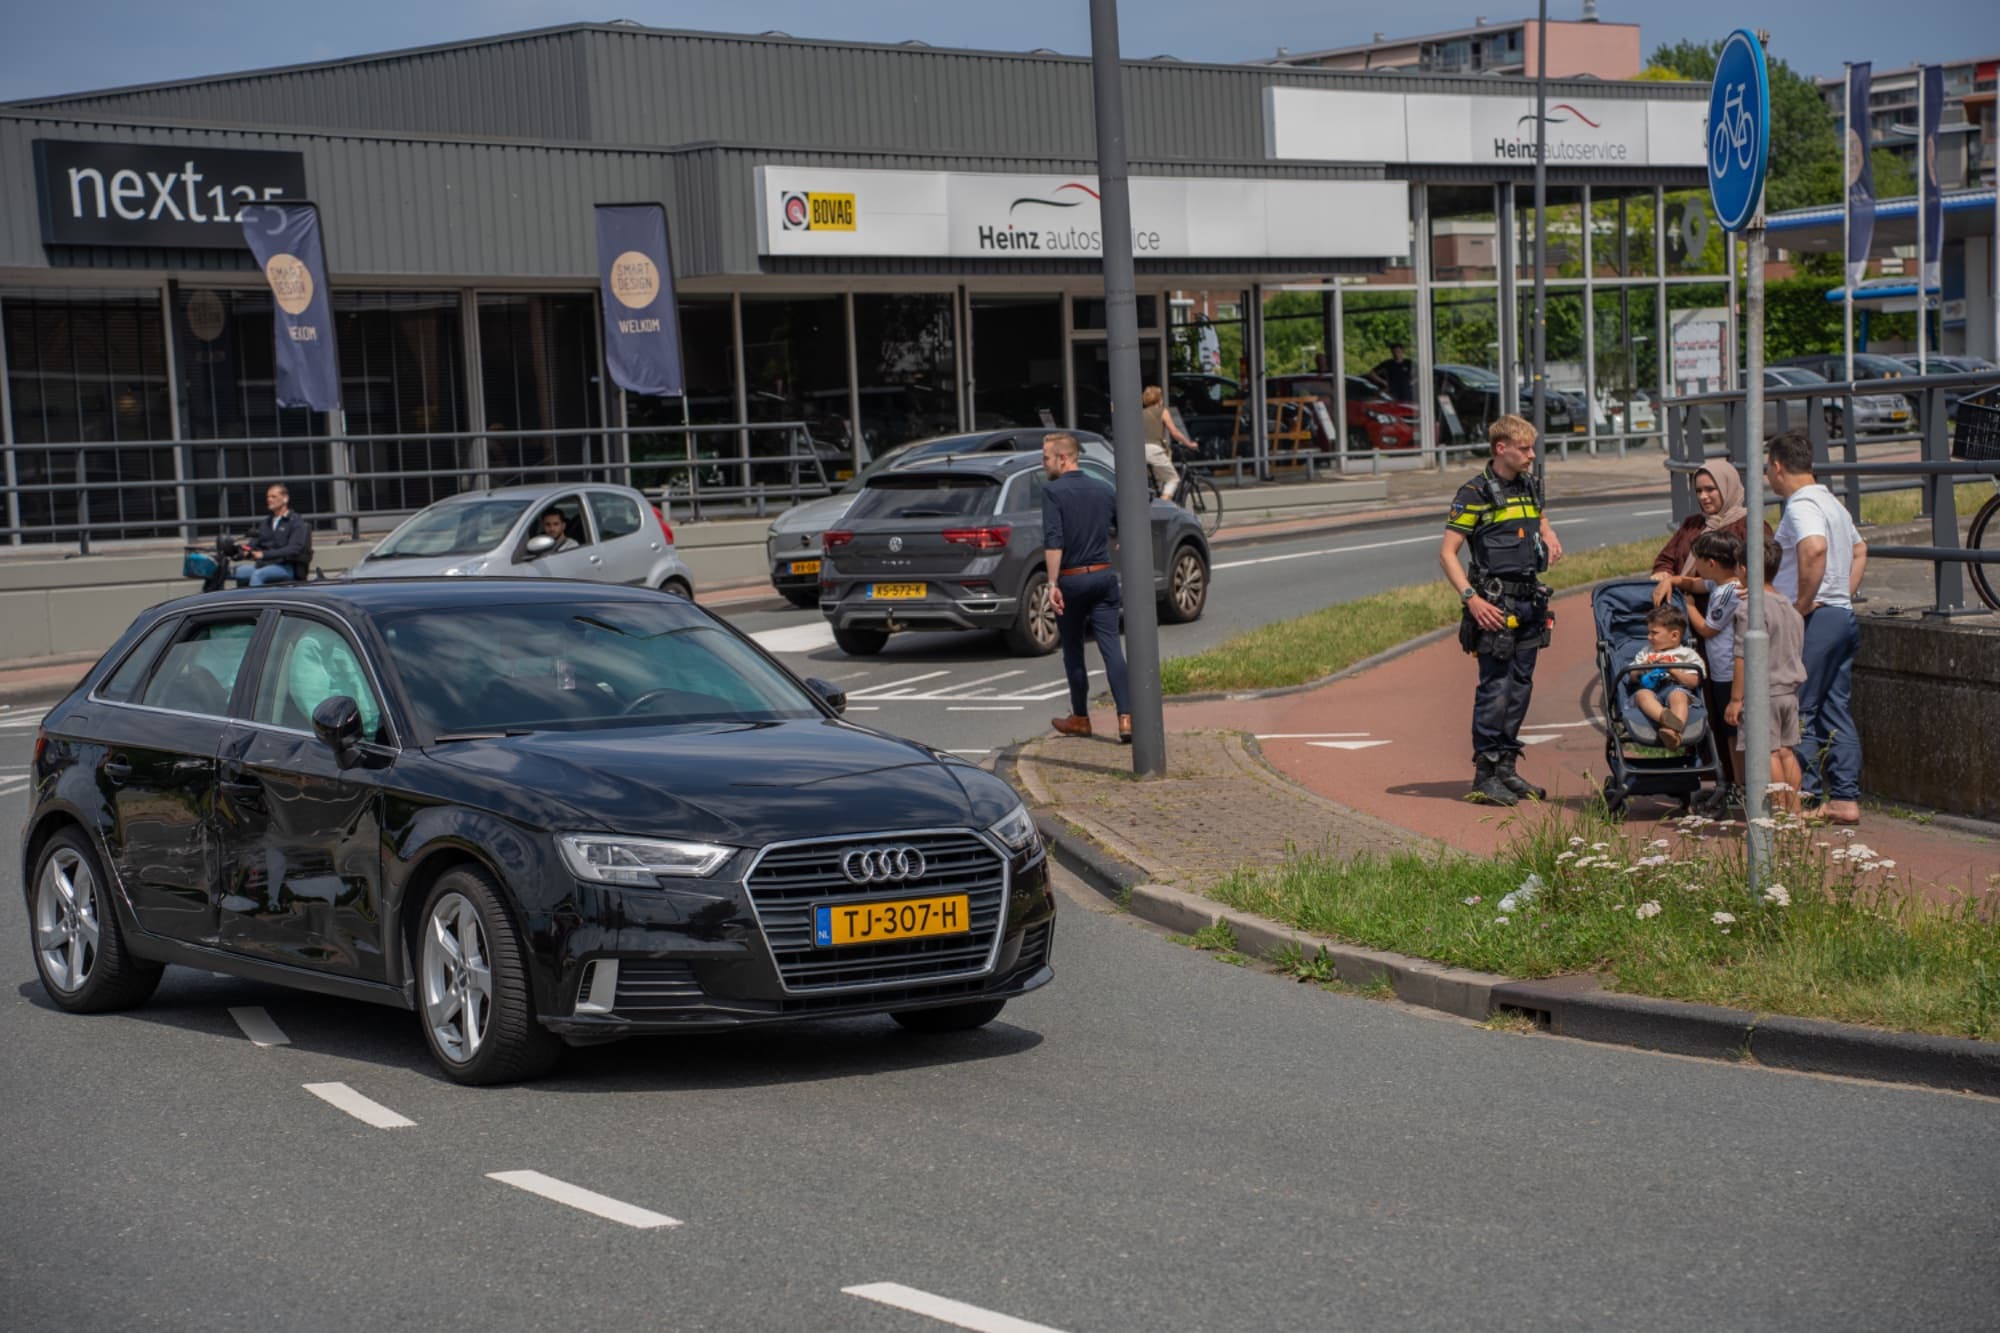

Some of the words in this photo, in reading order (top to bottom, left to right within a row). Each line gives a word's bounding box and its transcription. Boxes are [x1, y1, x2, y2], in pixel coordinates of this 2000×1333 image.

[1494, 137, 1539, 160] Heinz
[1545, 142, 1627, 160] autoservice
[813, 199, 852, 224] BOVAG
[979, 225, 1040, 250] Heinz
[1046, 226, 1160, 250] autosice
[617, 262, 650, 277] SMART
[617, 276, 653, 291] DESIGN
[618, 318, 661, 334] WELKOM
[844, 901, 957, 938] TJ-307-H
[818, 930, 830, 940] NL
